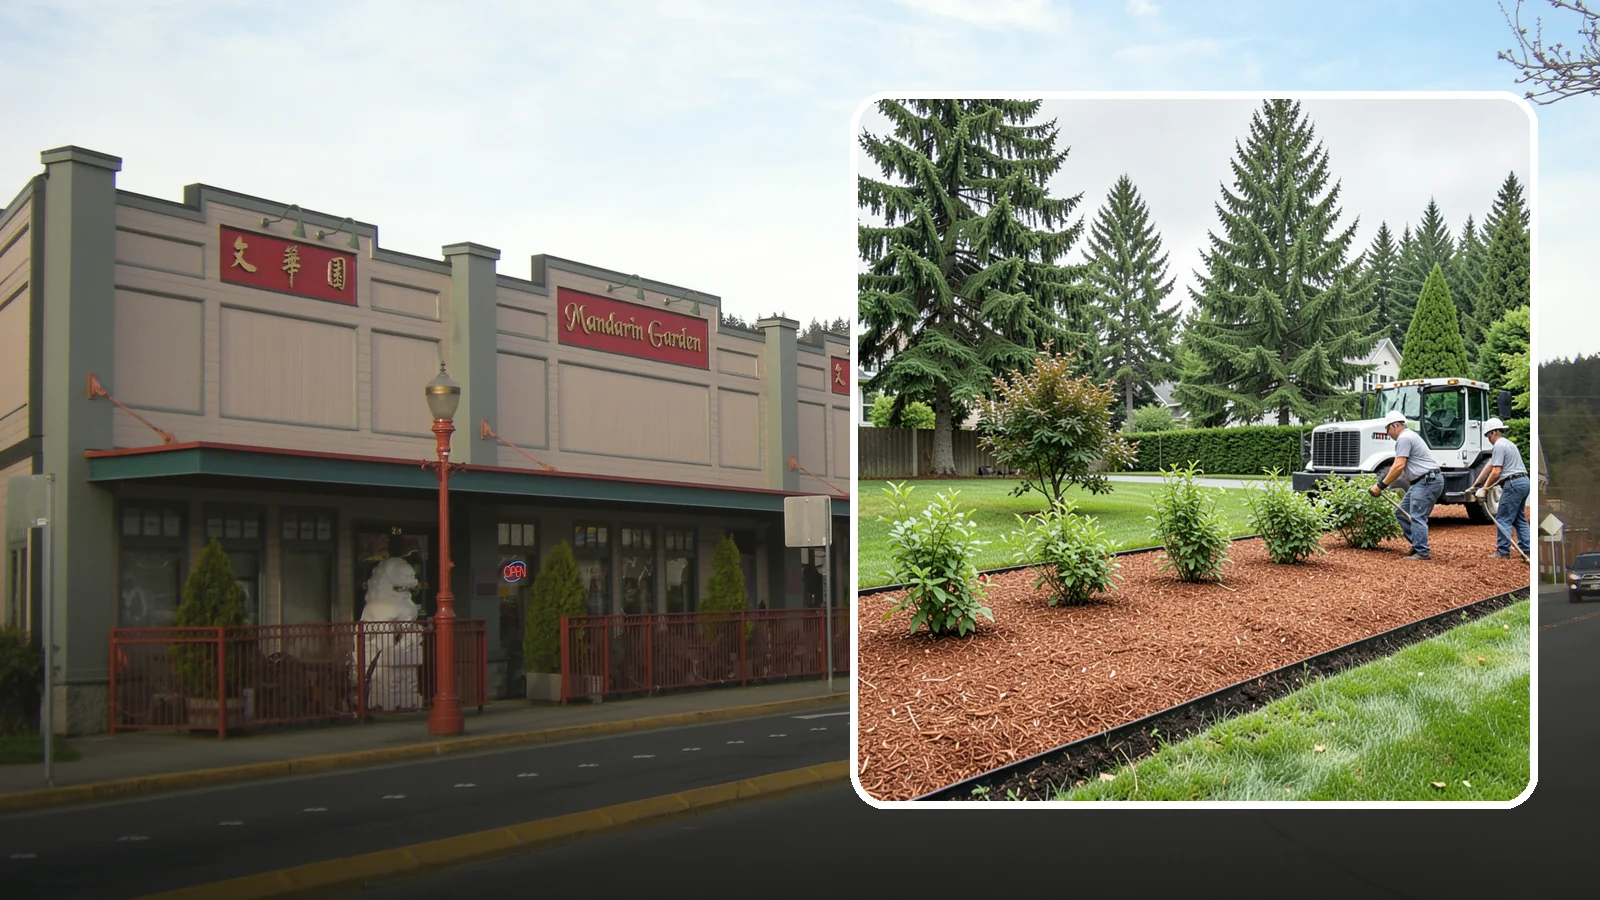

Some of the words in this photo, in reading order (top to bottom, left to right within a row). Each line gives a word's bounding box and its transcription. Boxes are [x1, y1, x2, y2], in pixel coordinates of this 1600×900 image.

[564, 302, 644, 341] Mandarin
[648, 320, 702, 352] Garden
[503, 565, 527, 578] OPEN
